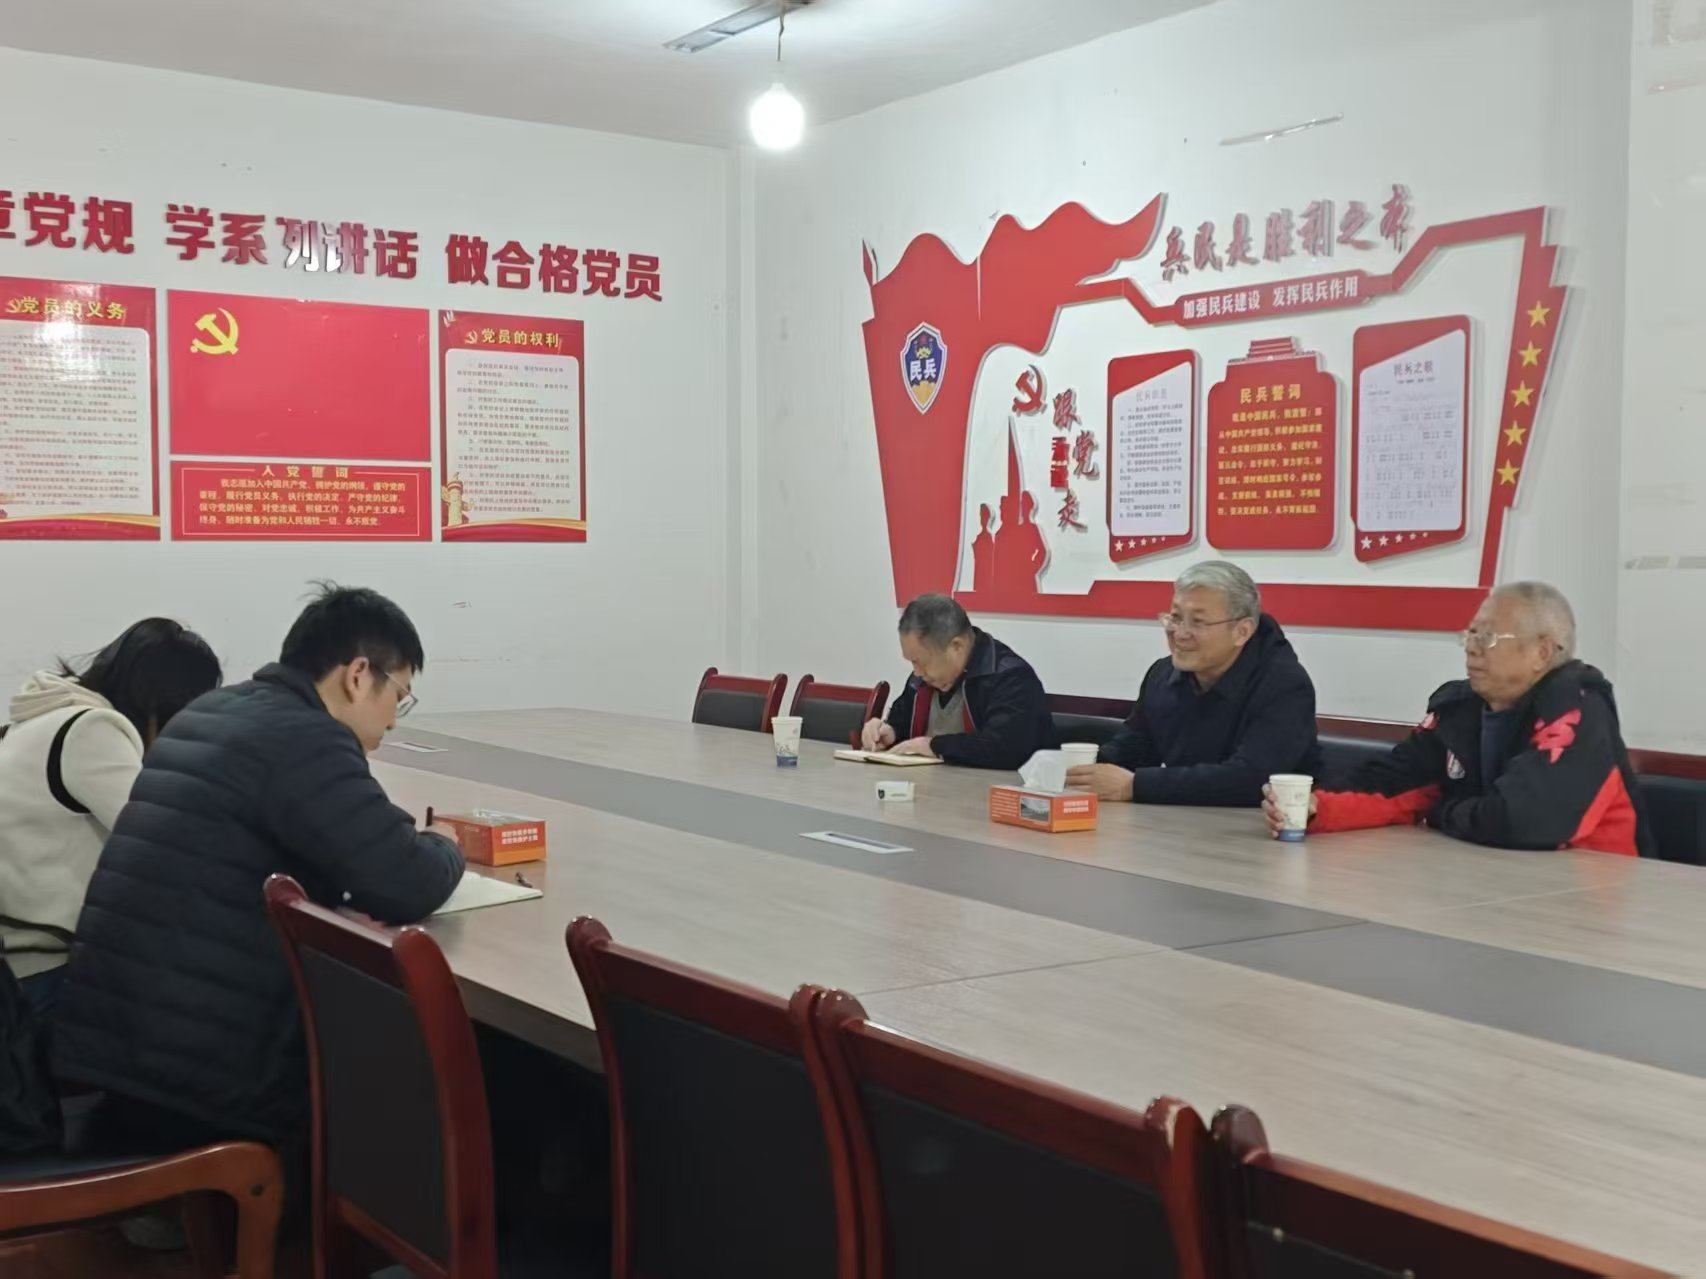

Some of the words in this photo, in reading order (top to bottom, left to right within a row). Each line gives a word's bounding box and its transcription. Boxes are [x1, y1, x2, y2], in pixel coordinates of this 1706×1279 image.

[1160, 183, 1411, 283] 兵民是胜利之本
[164, 204, 420, 281] 学系列讲话
[445, 233, 664, 303] 做合格党员
[21, 296, 126, 320] 党员的义务
[1182, 291, 1261, 320] 加强民兵建设
[1272, 276, 1359, 308] 发挥民兵作用
[481, 328, 561, 348] 党员的权利
[910, 358, 937, 381] 民兵
[1240, 384, 1301, 404] 民兵誓词
[261, 464, 349, 479] 入党誓词
